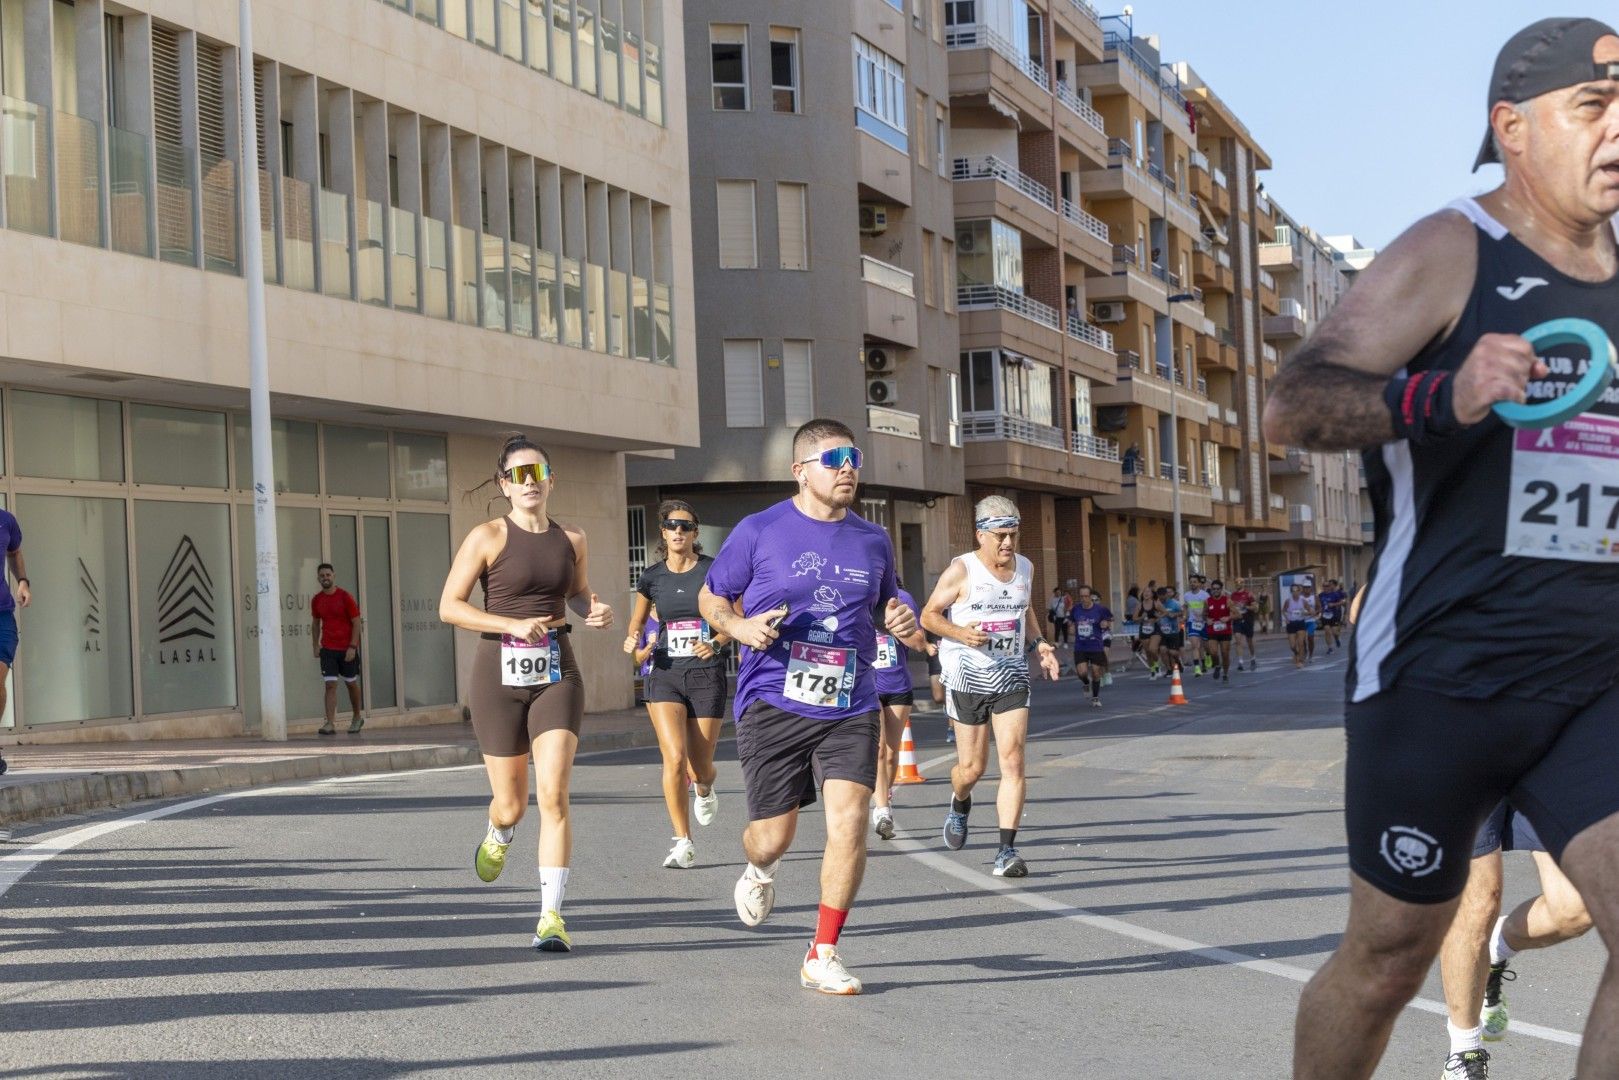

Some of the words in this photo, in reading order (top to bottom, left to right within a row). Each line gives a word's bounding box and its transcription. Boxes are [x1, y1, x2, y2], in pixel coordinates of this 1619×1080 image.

[1520, 479, 1619, 530] 217
[160, 647, 216, 664] LASAL
[551, 650, 559, 666] KM
[506, 656, 547, 675] 190
[792, 671, 838, 695] 178
[842, 671, 854, 690] KM
